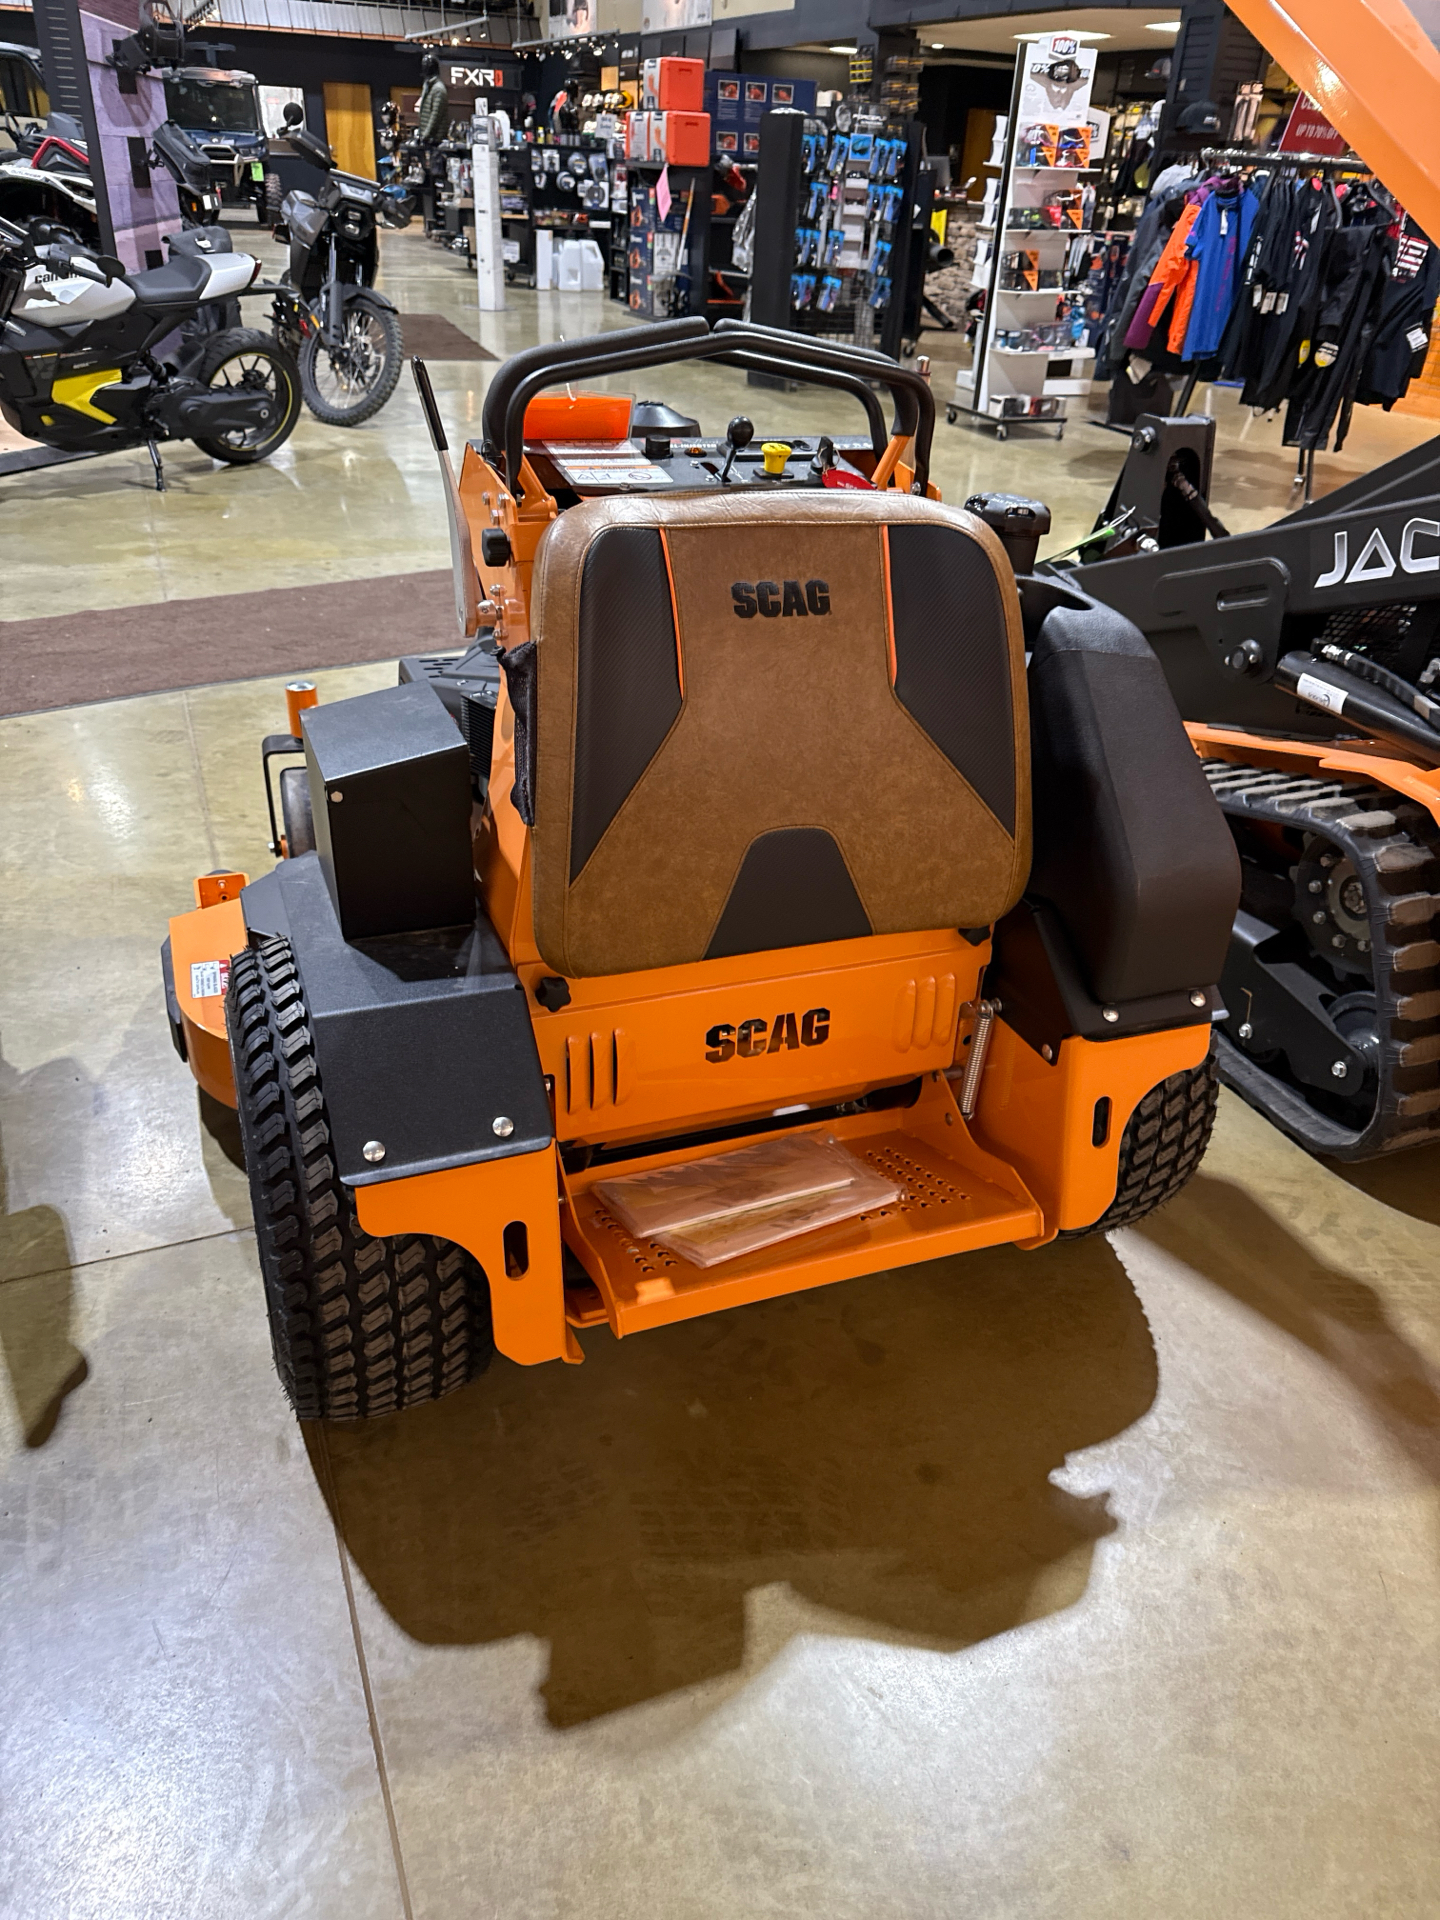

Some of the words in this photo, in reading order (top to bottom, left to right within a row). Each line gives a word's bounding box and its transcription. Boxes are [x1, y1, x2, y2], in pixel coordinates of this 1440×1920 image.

[1053, 39, 1077, 53] 100%
[731, 579, 831, 619] SCAG
[705, 1007, 831, 1064] SCAG
